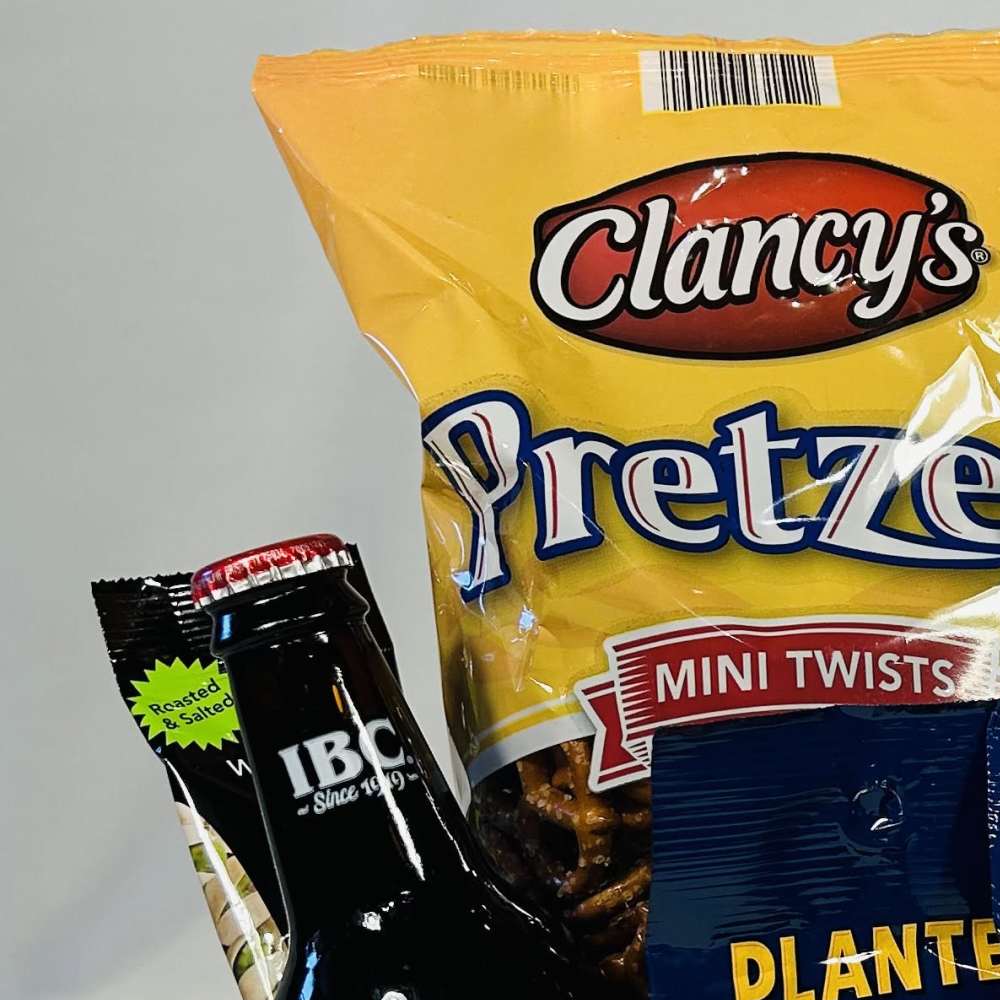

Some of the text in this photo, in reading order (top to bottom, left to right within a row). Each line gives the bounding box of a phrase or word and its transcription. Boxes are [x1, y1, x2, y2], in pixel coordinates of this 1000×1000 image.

[655, 649, 956, 703] MINI TWISTS
[148, 677, 221, 715] Roasted
[162, 692, 235, 730] & Salted
[278, 717, 406, 800] IBC
[313, 784, 360, 815] Since
